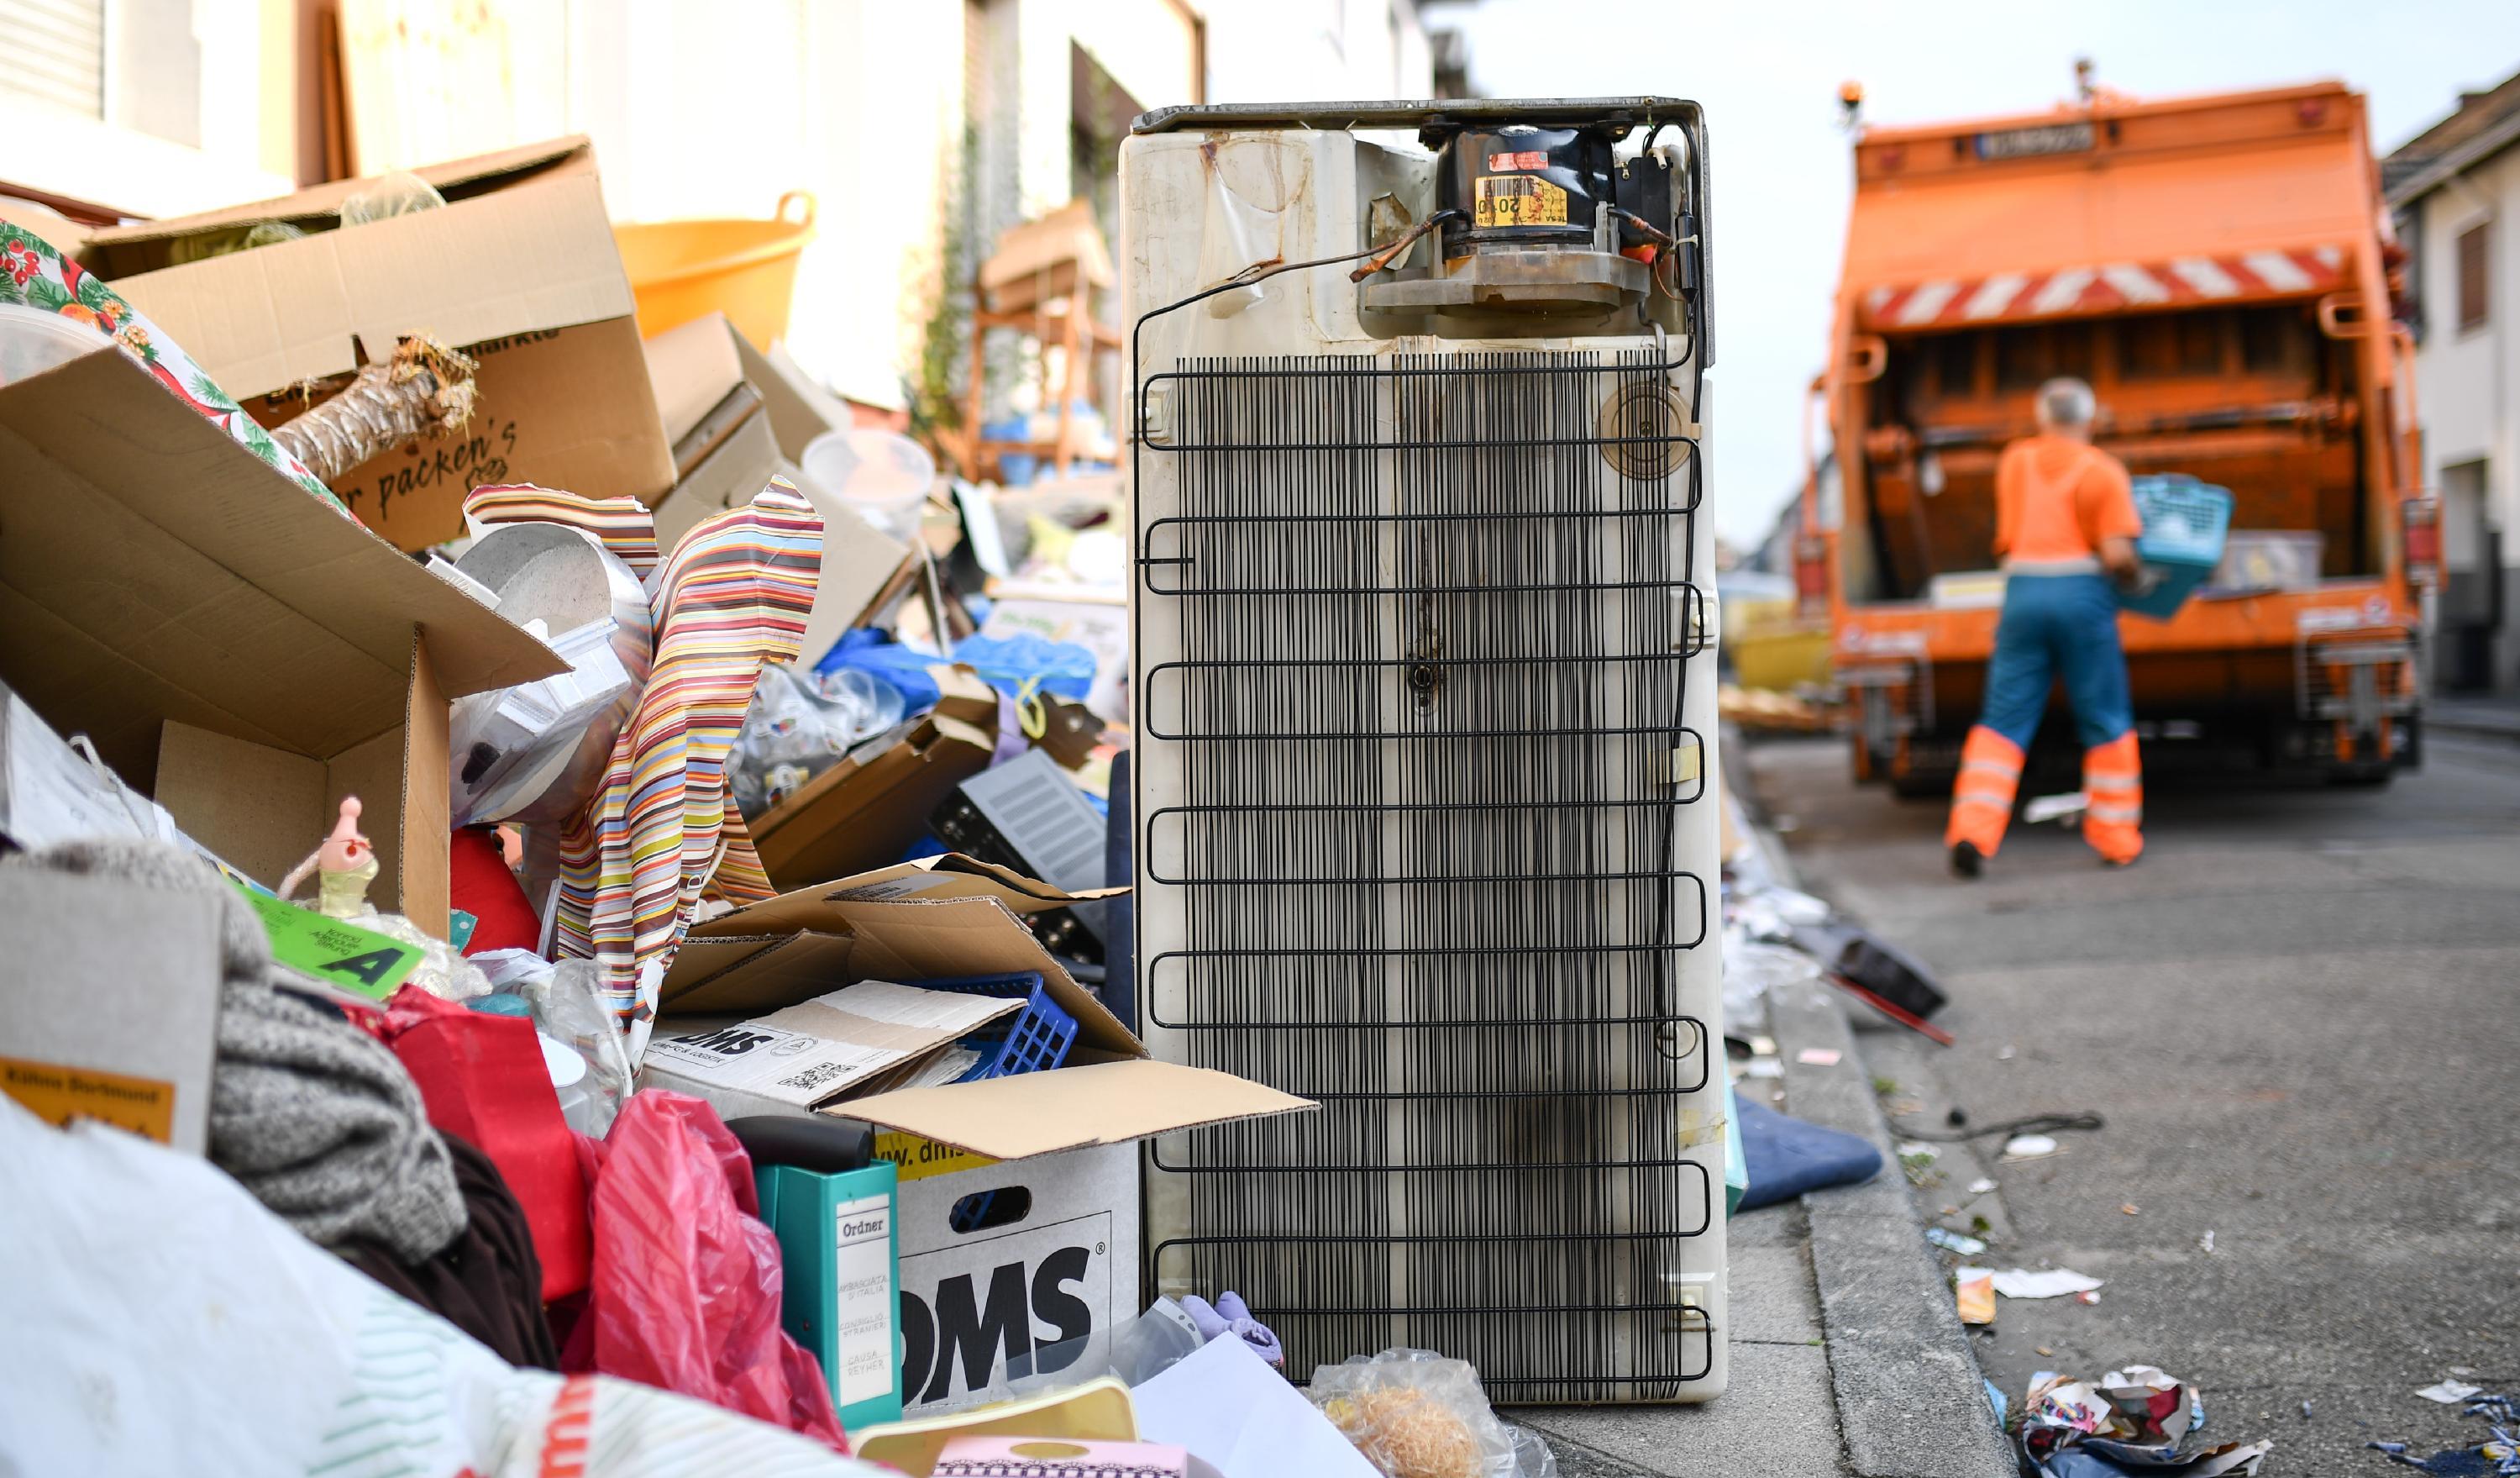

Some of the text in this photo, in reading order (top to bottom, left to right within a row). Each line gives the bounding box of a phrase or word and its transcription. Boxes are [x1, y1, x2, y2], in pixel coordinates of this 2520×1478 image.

[379, 418, 516, 521] packen's
[843, 1220, 884, 1237] Ordner
[900, 1246, 1091, 1407] DMS
